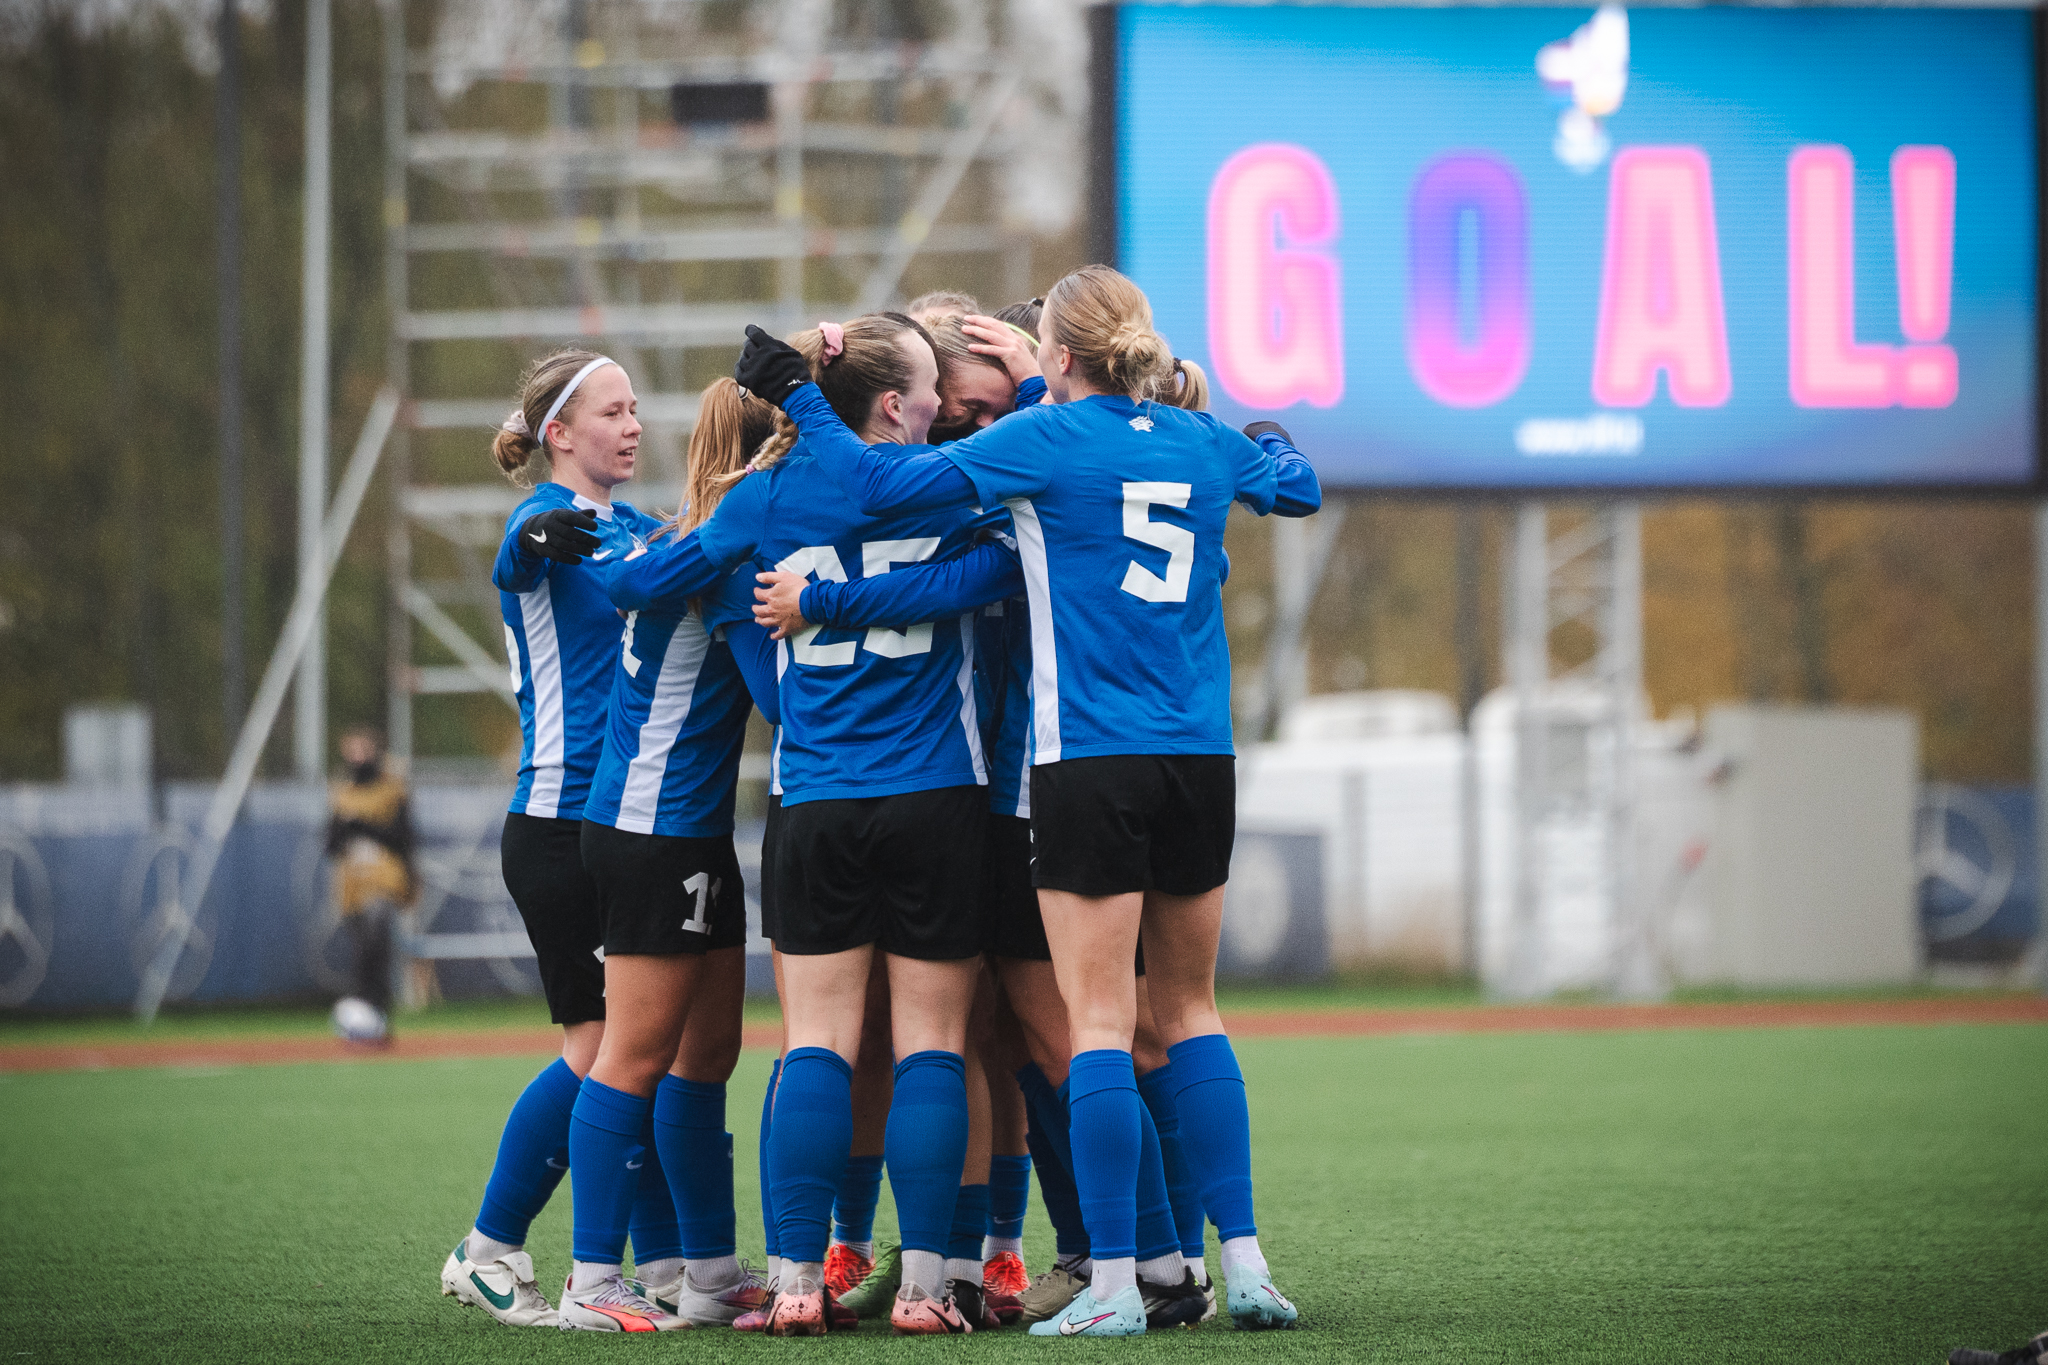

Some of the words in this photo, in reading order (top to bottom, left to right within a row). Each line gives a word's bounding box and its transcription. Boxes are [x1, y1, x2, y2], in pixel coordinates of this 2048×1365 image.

[1206, 142, 1961, 411] GOAL!
[774, 536, 941, 668] 25
[1120, 481, 1195, 603] 5
